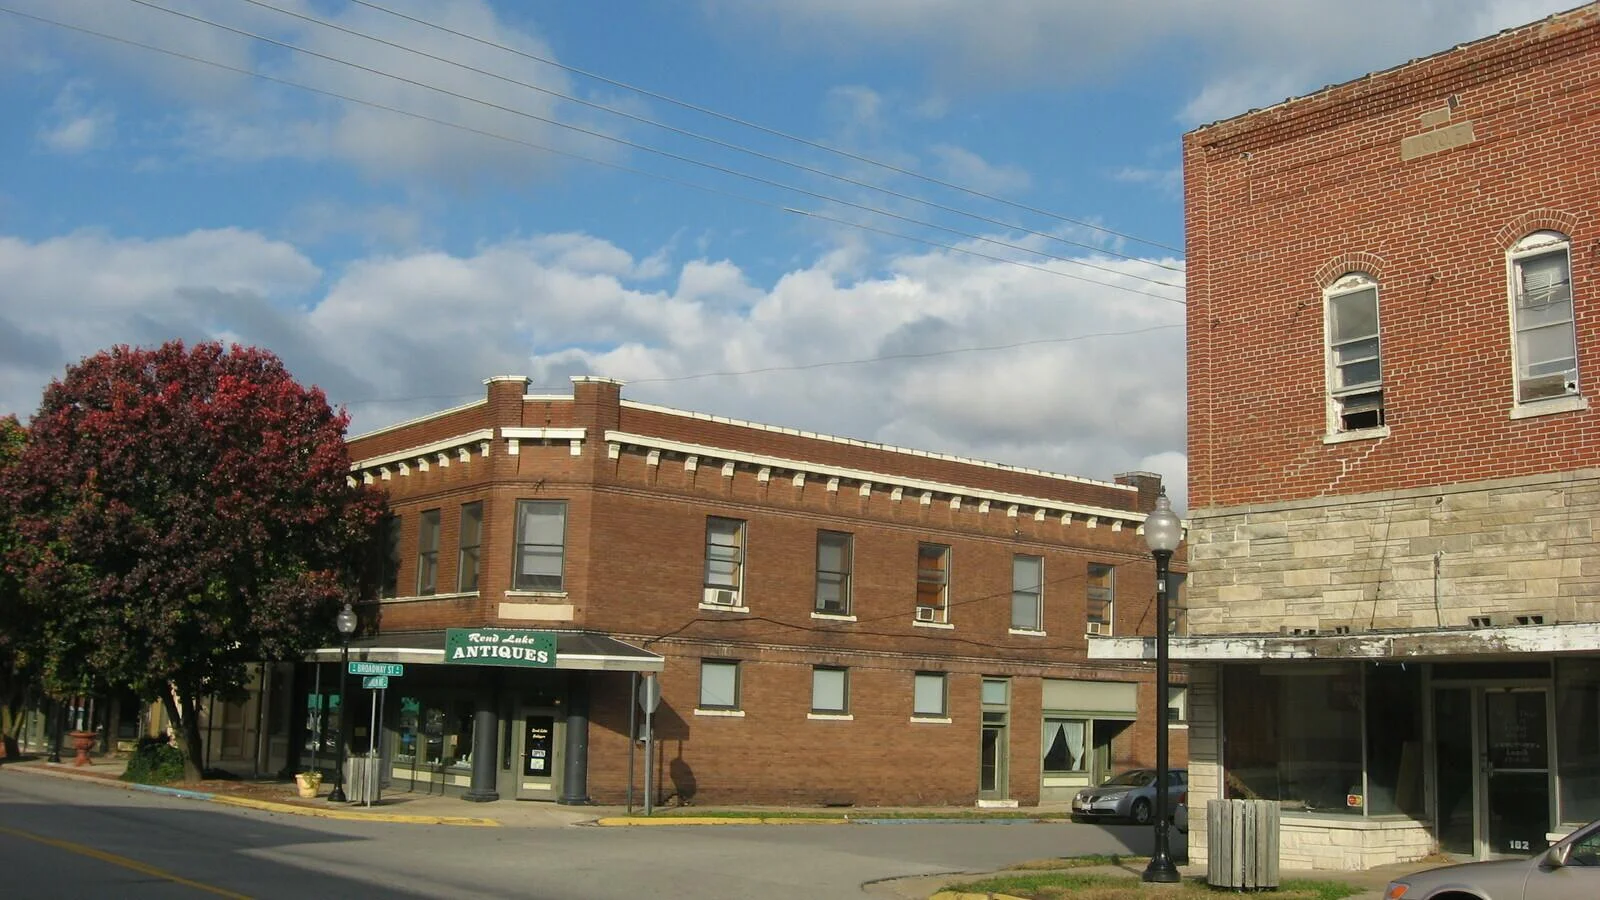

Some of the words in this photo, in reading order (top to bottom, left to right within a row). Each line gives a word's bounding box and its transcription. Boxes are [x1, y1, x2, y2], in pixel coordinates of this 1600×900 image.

[468, 632, 500, 643] Rend
[502, 634, 535, 645] Lake
[452, 645, 549, 664] ANTIQUES
[357, 663, 386, 674] BROADWAY
